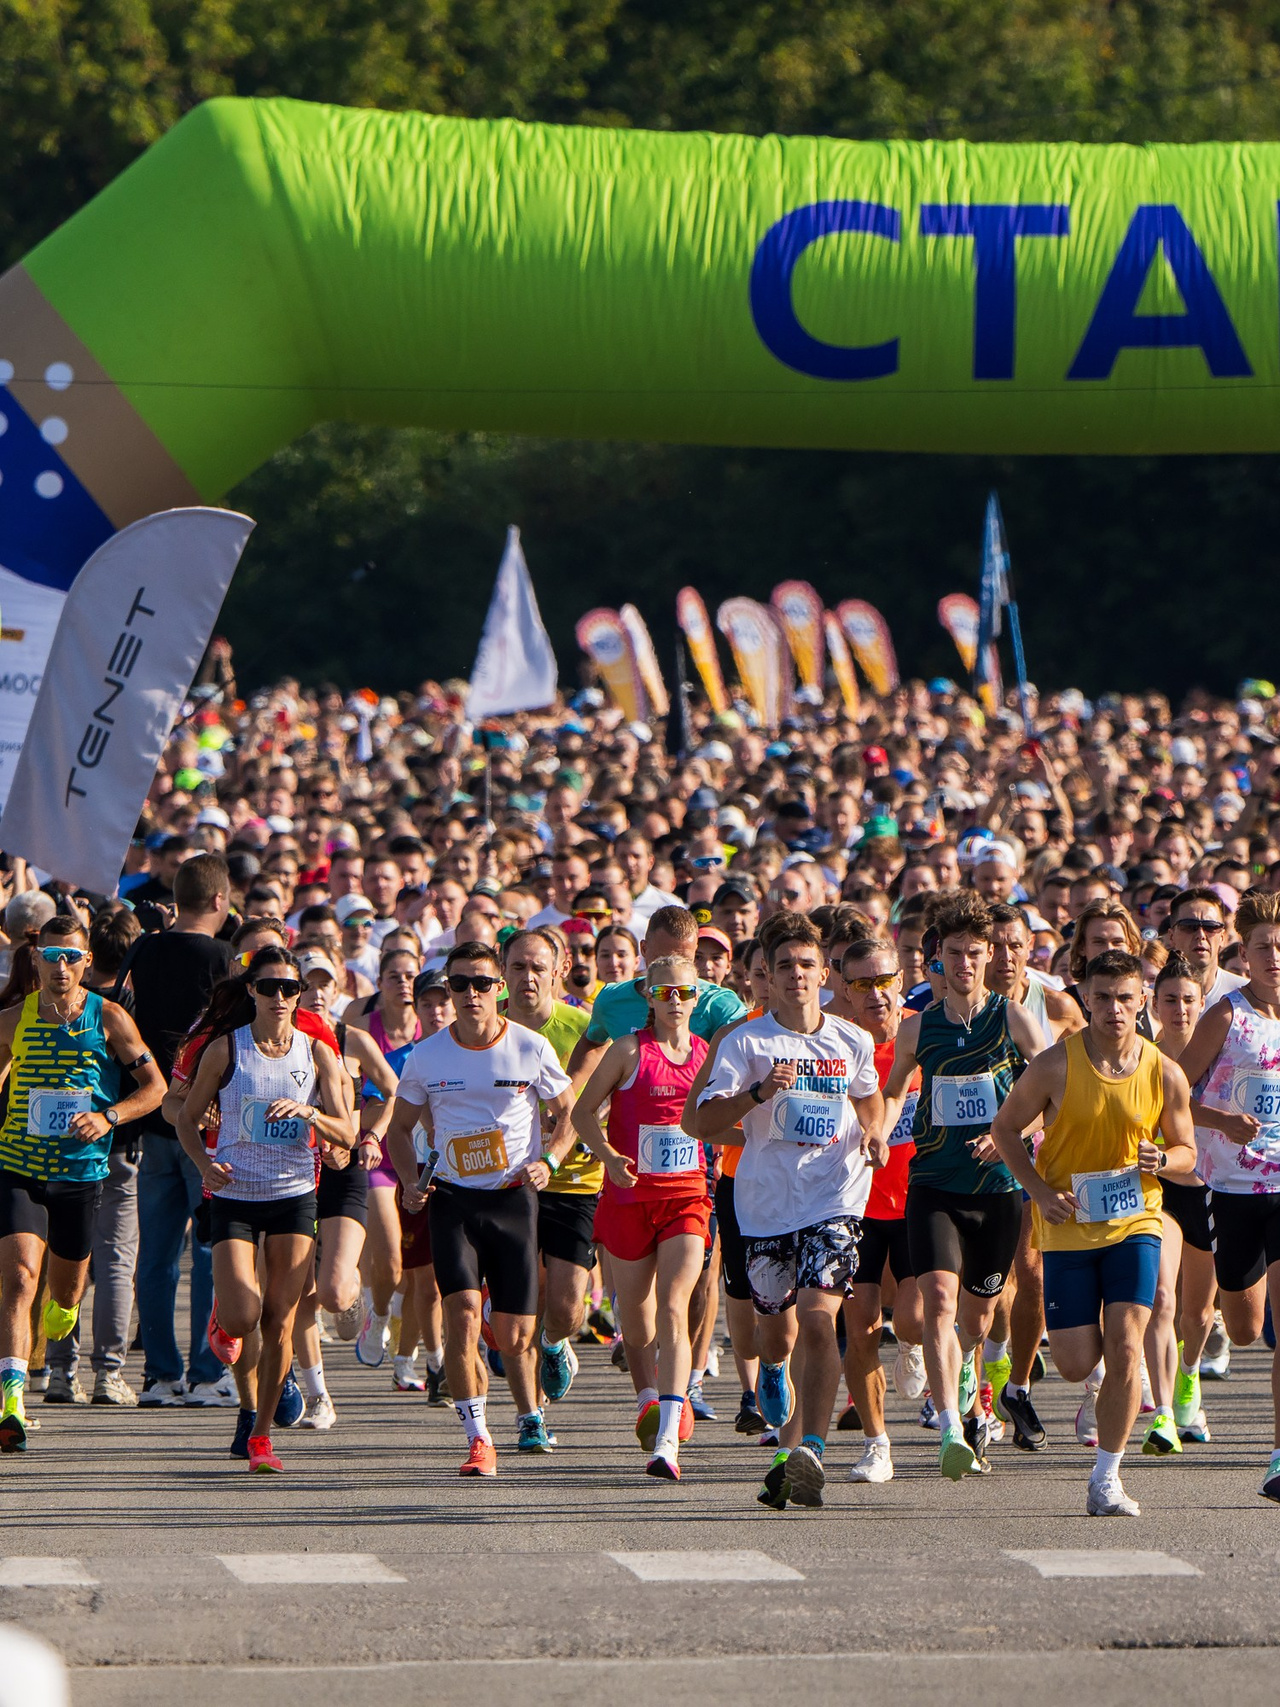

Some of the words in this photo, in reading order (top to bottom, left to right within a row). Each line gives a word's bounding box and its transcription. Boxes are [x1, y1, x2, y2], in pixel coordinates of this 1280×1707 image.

[65, 586, 156, 808] TENET
[959, 1087, 978, 1097] ИЛЬЯ
[56, 1101, 78, 1110] ДЕНИС
[802, 1104, 830, 1115] РОДИОН
[955, 1098, 987, 1119] 308
[48, 1111, 77, 1130] 23
[263, 1119, 299, 1140] 1623
[794, 1115, 836, 1138] 4065
[468, 1138, 491, 1150] ПАВЕЛ
[462, 1146, 504, 1172] 6004.1
[661, 1146, 694, 1168] 2127
[1102, 1177, 1132, 1193] АЛЕКСЕЙ
[1100, 1189, 1139, 1215] 1285
